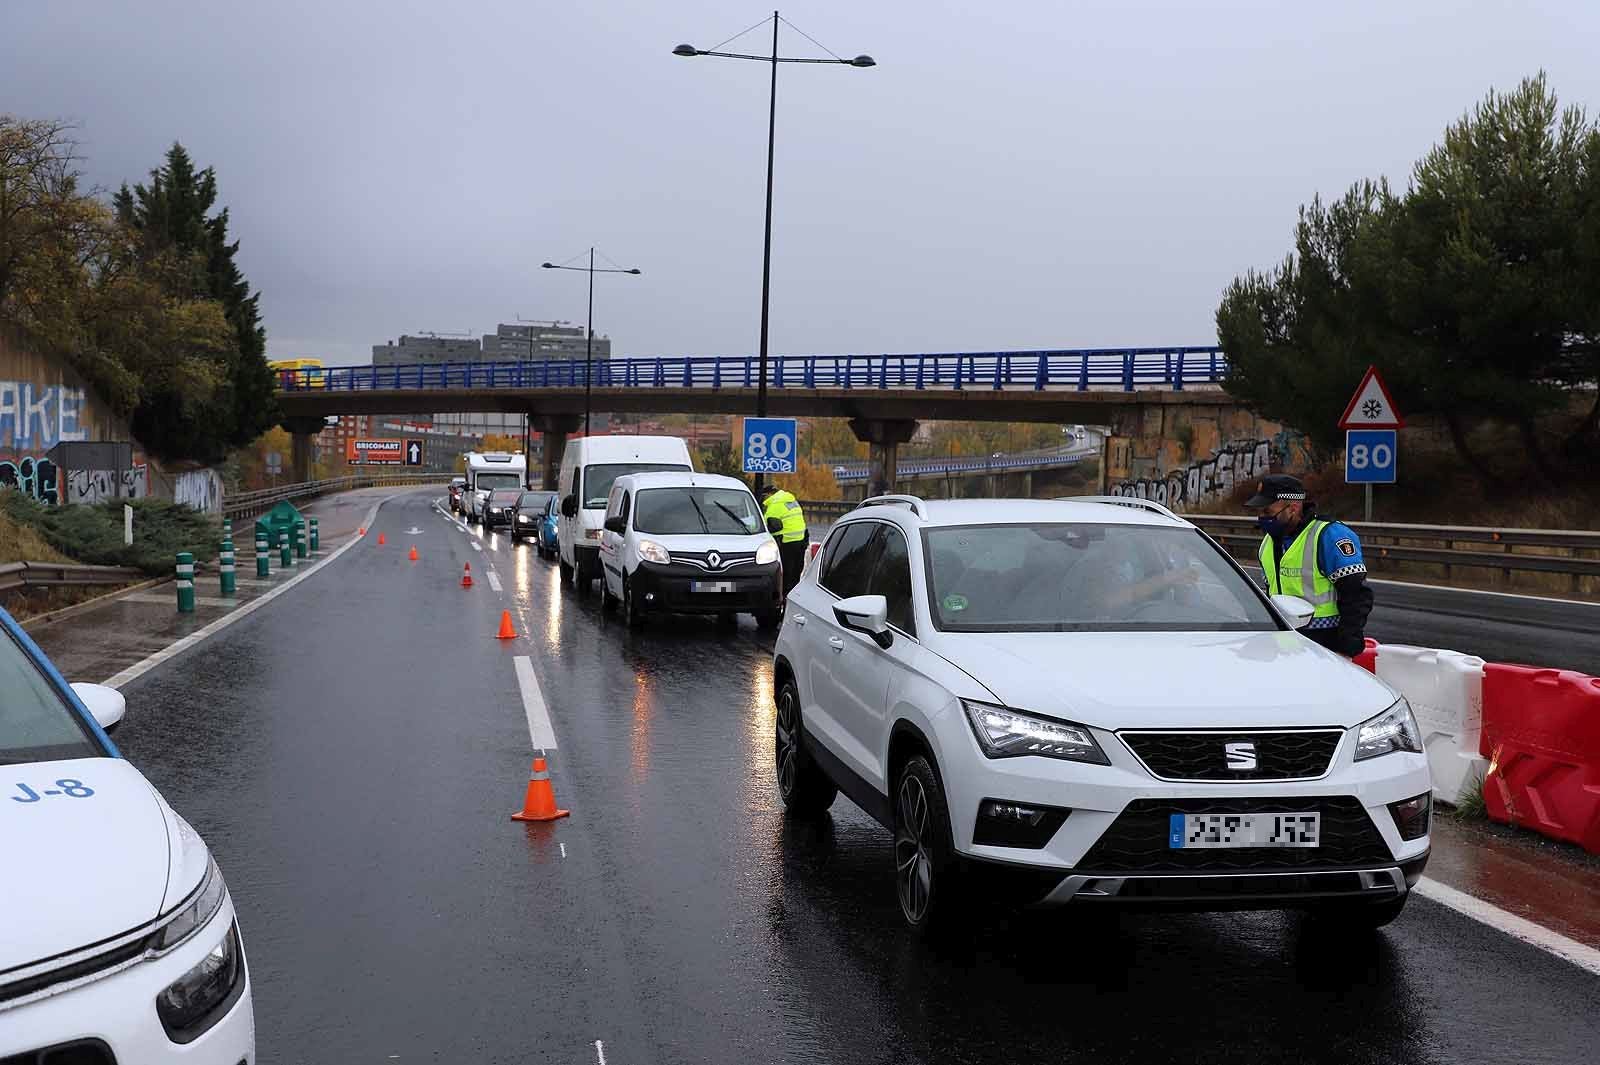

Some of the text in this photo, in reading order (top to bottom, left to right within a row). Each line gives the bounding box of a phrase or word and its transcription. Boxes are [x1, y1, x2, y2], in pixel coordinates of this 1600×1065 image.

[356, 442, 400, 450] BRICOMART
[748, 432, 791, 458] 80
[1351, 443, 1392, 470] 80
[11, 778, 96, 803] J-8
